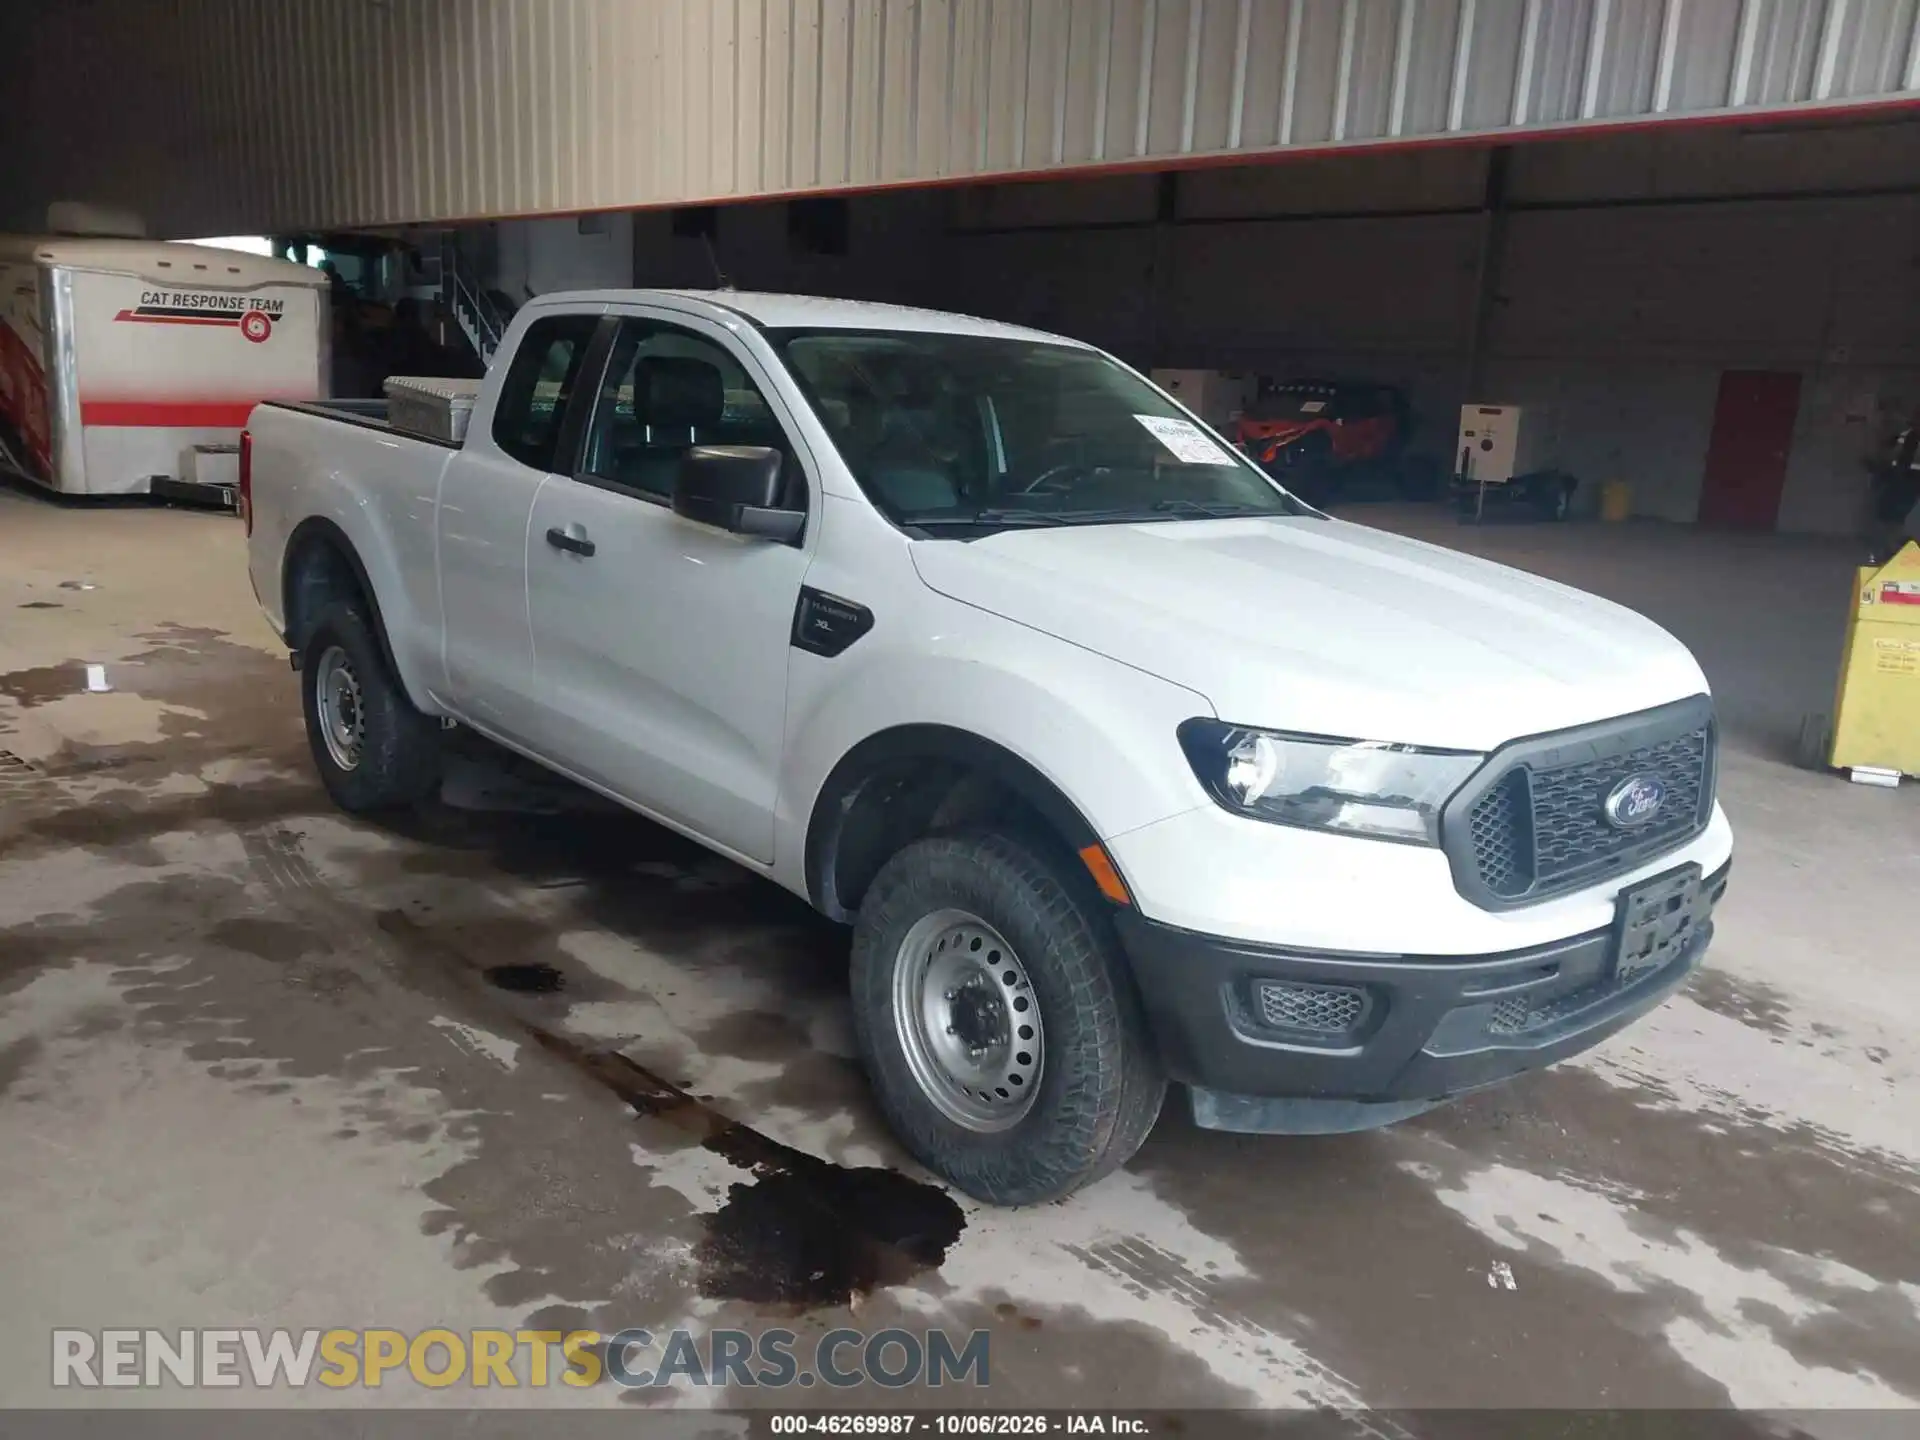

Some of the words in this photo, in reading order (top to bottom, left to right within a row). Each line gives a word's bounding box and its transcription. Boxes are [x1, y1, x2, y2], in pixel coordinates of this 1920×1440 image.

[141, 292, 169, 305] CAT
[172, 293, 245, 310] RESPONSE
[250, 297, 284, 312] TEAM
[1628, 785, 1659, 817] Ford
